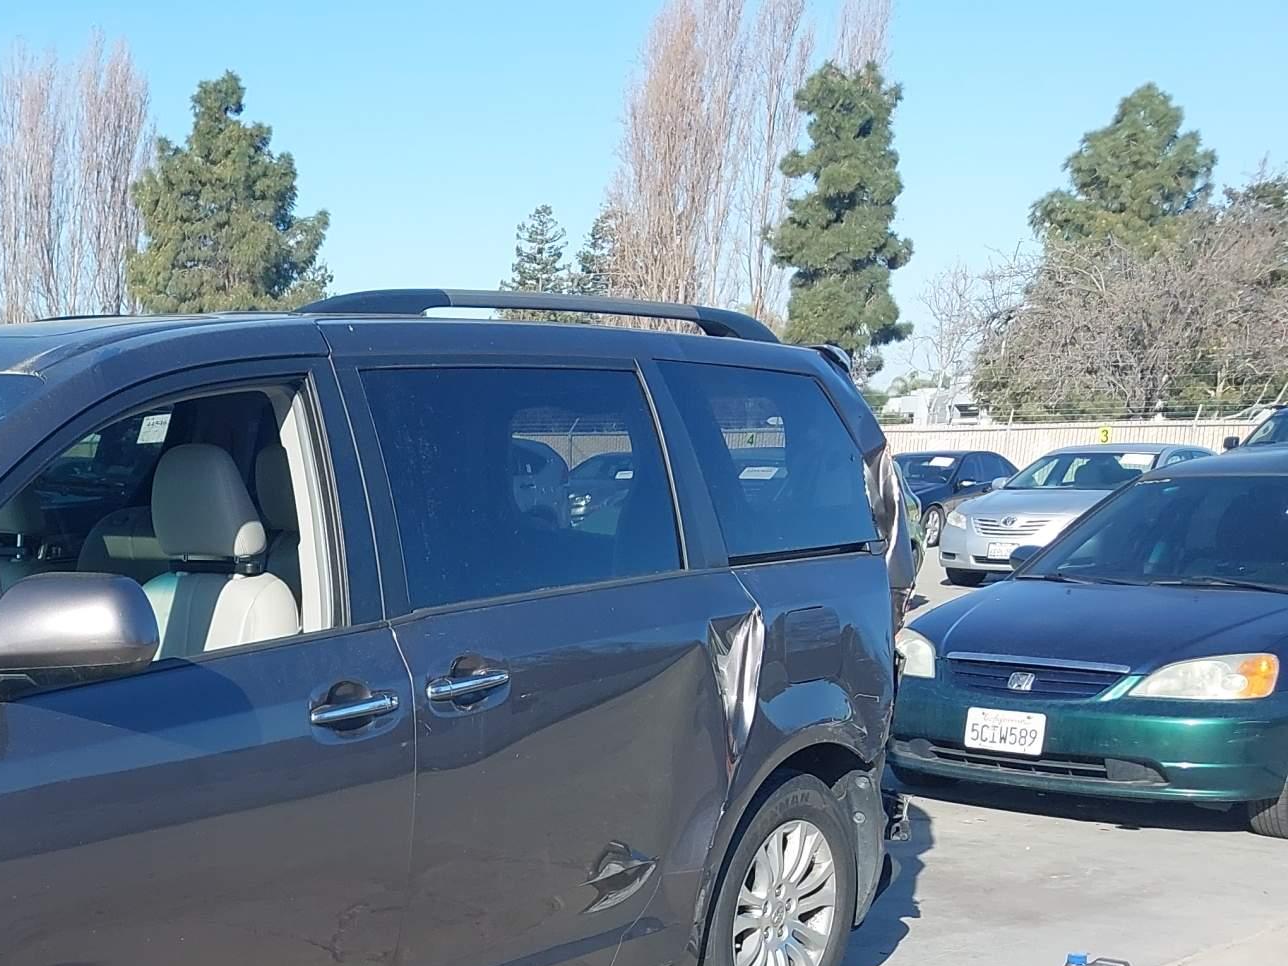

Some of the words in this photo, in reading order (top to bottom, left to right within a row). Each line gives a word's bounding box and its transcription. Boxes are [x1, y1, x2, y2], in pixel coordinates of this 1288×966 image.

[746, 434, 755, 446] 4
[1100, 429, 1109, 443] 3
[970, 722, 1038, 747] 5CIW589
